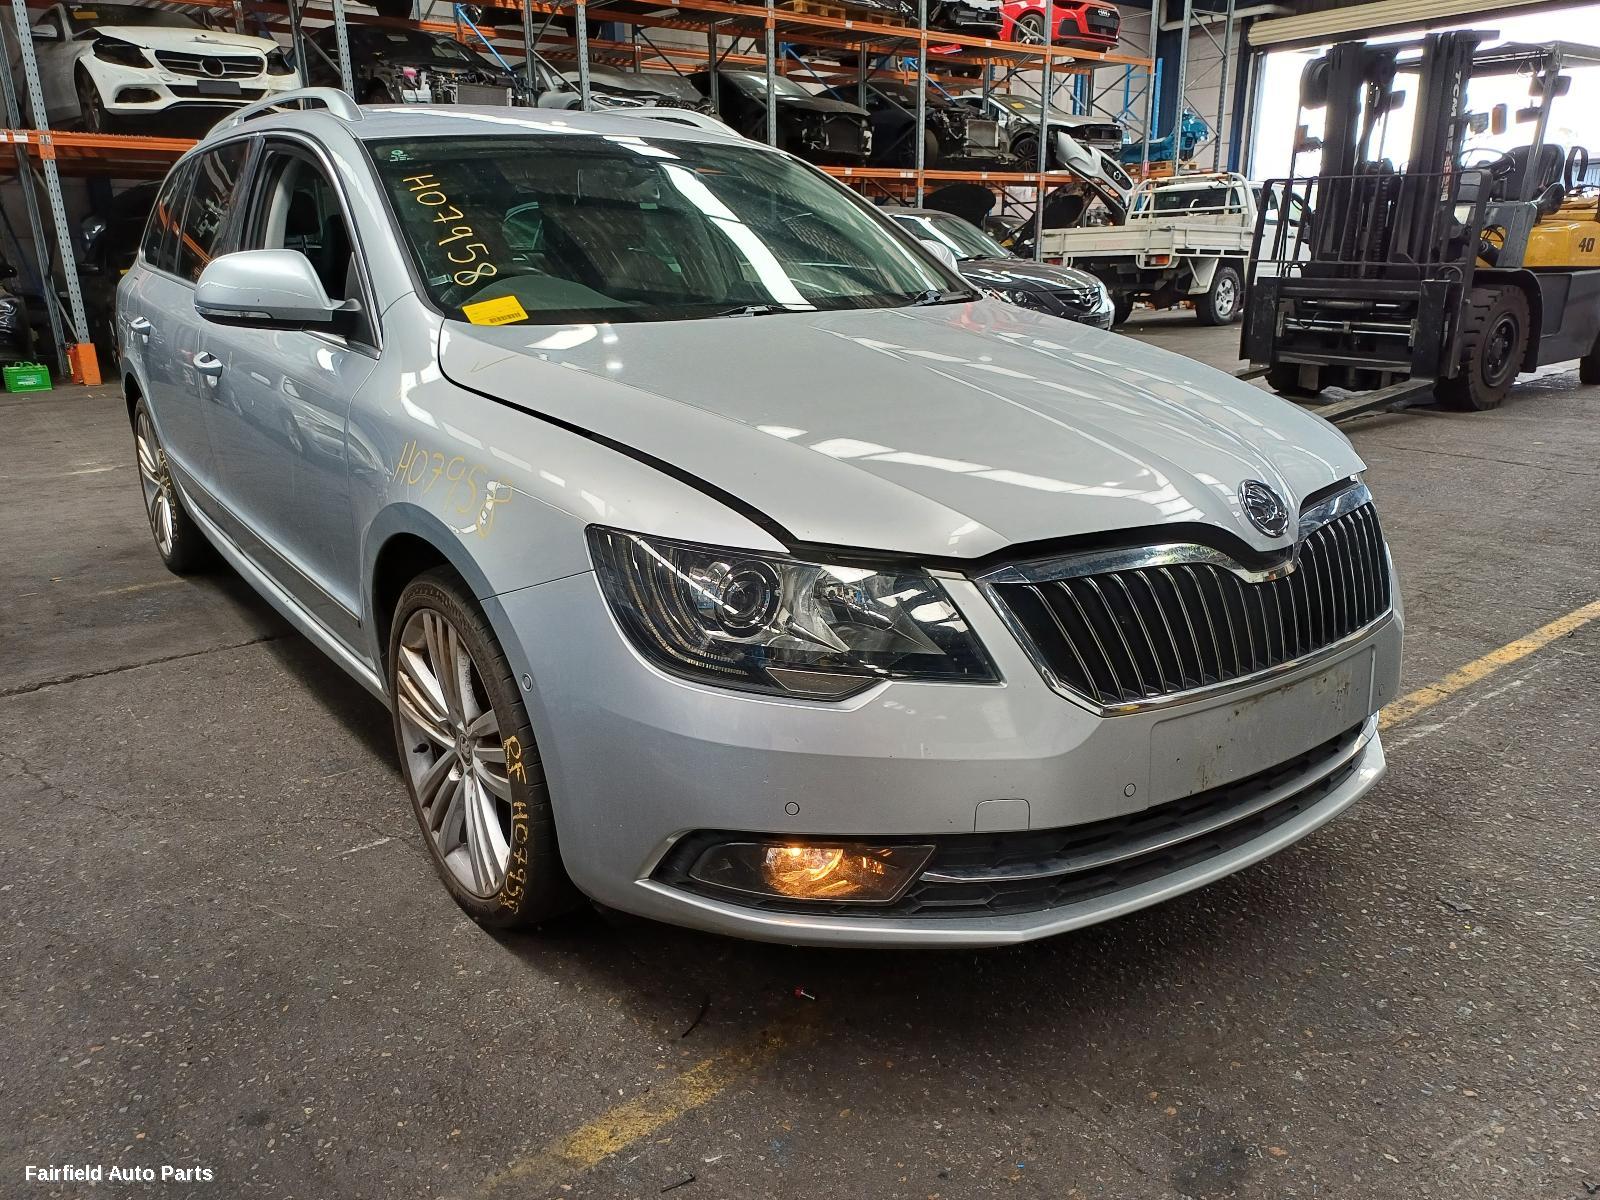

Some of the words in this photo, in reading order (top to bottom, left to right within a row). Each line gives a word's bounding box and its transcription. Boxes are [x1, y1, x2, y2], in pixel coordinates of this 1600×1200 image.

[1450, 70, 1462, 117] TCM
[402, 173, 498, 286] H07958
[1578, 237, 1596, 253] 40
